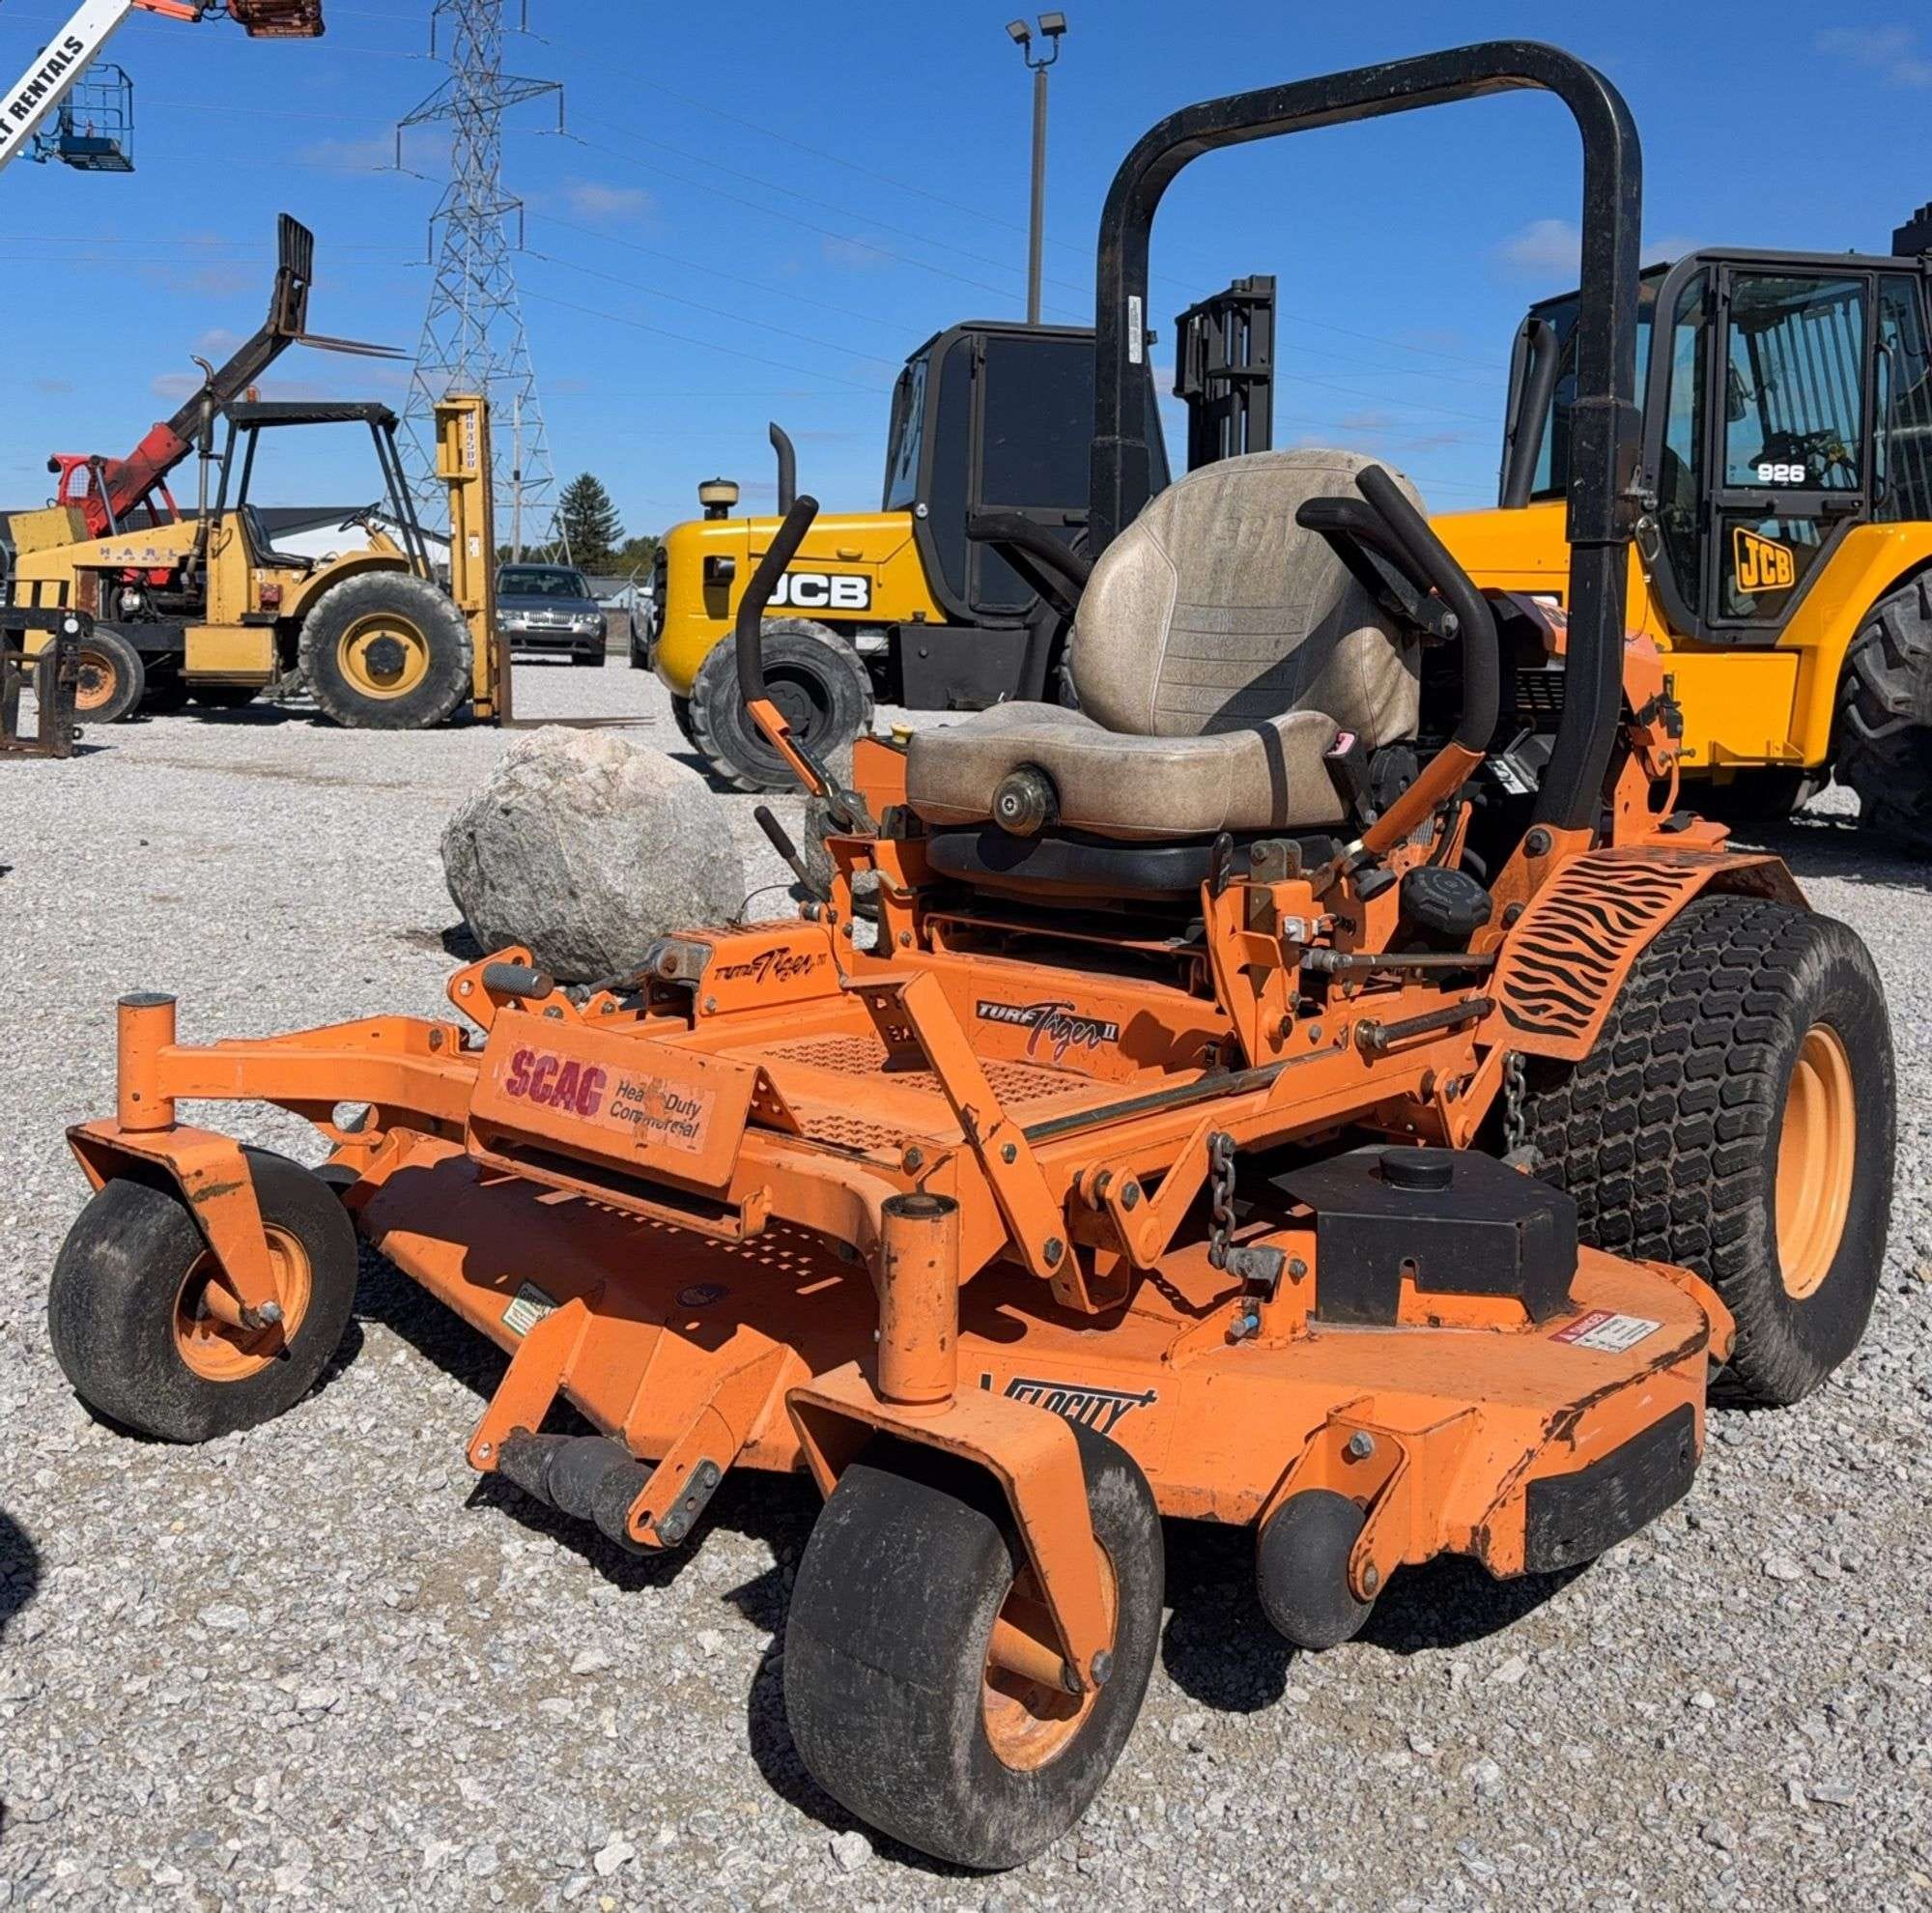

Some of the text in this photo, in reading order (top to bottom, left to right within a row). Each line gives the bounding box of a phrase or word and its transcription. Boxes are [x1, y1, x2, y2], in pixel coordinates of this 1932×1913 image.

[8, 36, 84, 121] RENTALS
[1758, 464, 1805, 482] 926
[1741, 536, 1790, 586] JCB
[766, 573, 868, 609] JCB
[979, 1001, 1118, 1061] TURF Tiger II
[506, 1048, 607, 1118] SCAG
[665, 1094, 702, 1120] Duty
